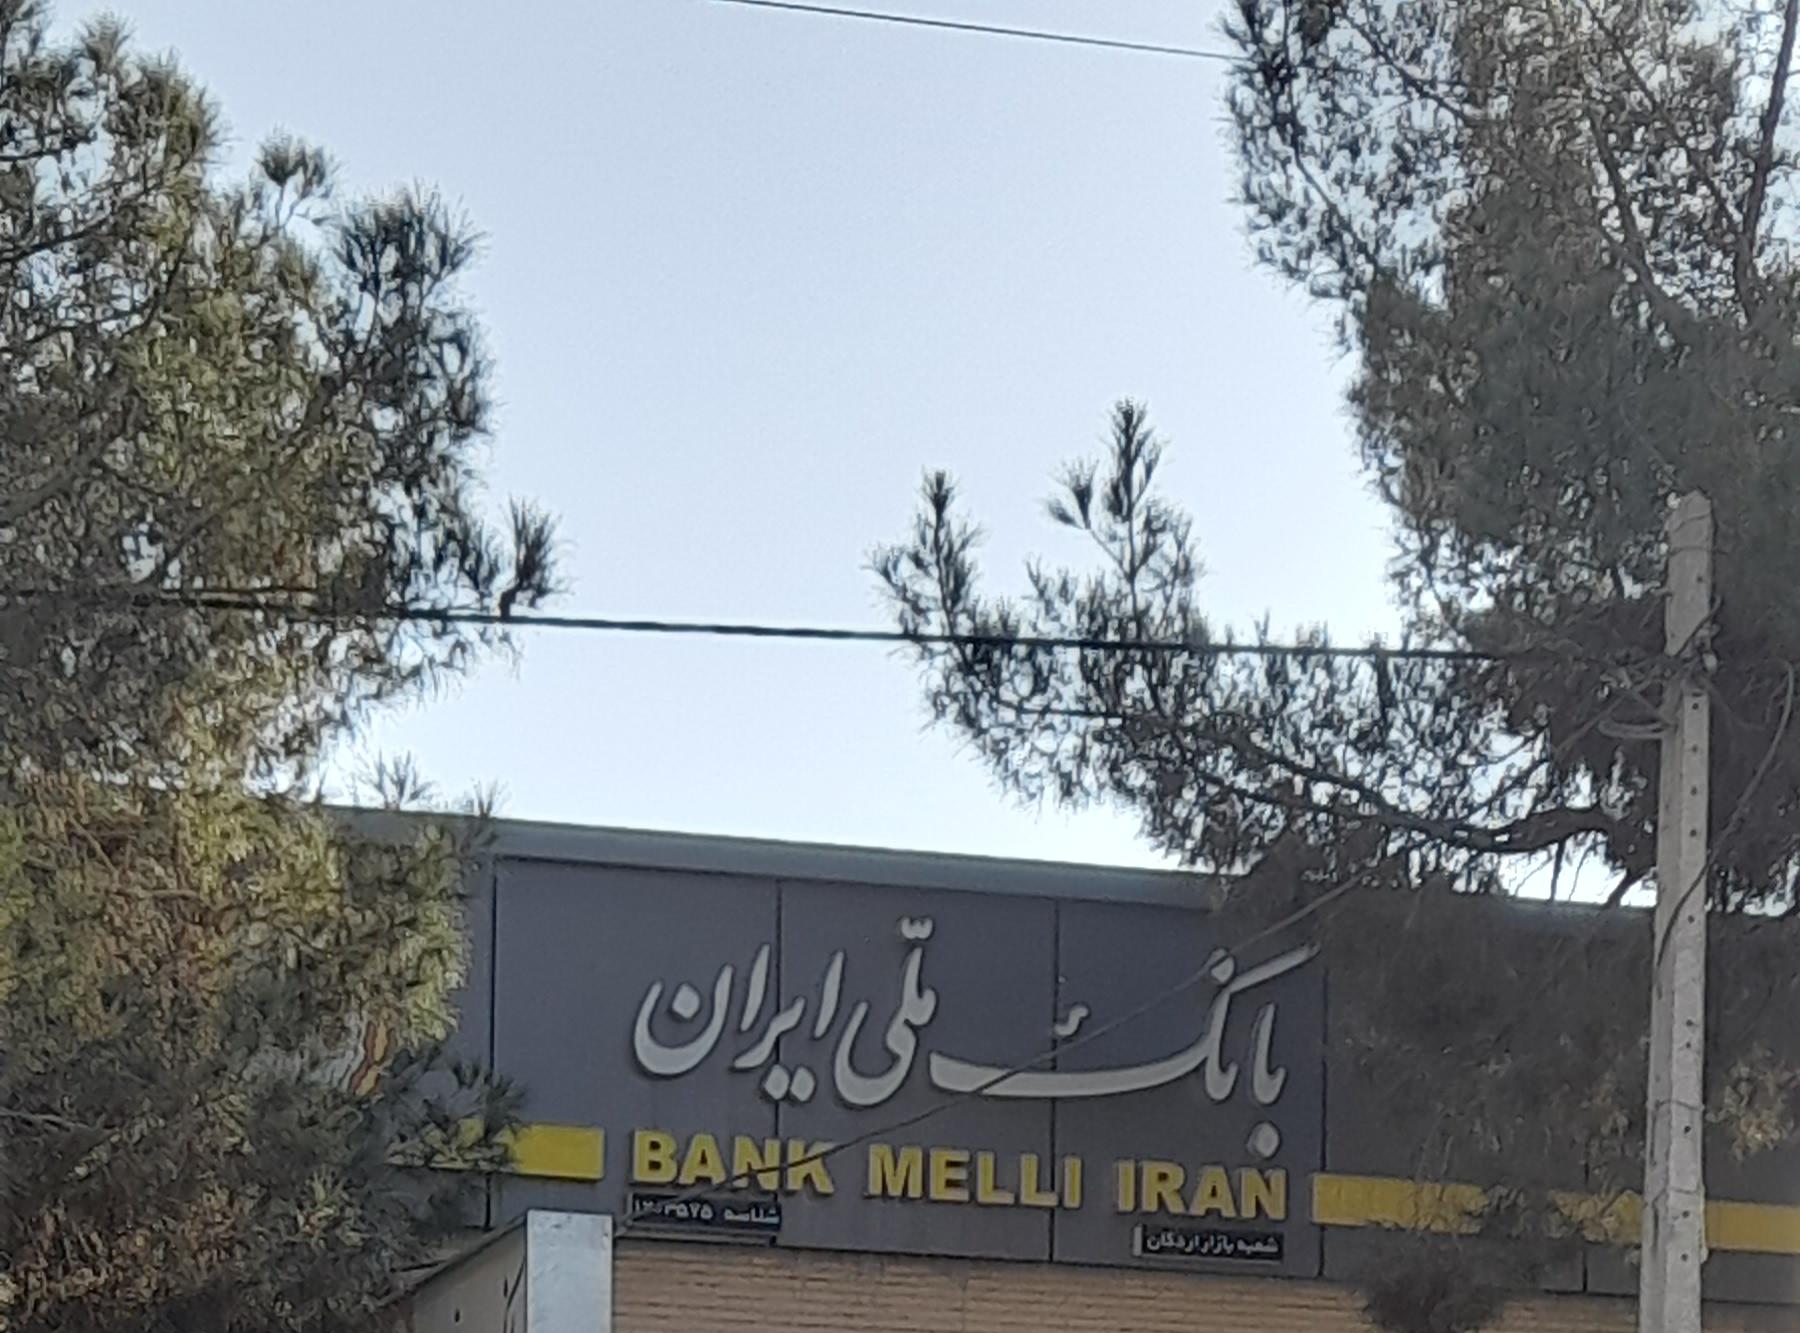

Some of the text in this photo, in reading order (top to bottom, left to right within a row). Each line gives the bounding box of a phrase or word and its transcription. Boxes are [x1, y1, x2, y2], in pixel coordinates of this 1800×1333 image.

[633, 943, 845, 1102] ایران
[929, 942, 1320, 1160] بانک
[632, 1127, 1288, 1221] BANK MELLI IRAN
[723, 1206, 780, 1224] شناسه
[1146, 1231, 1279, 1255] شعبه بازار اردکان
